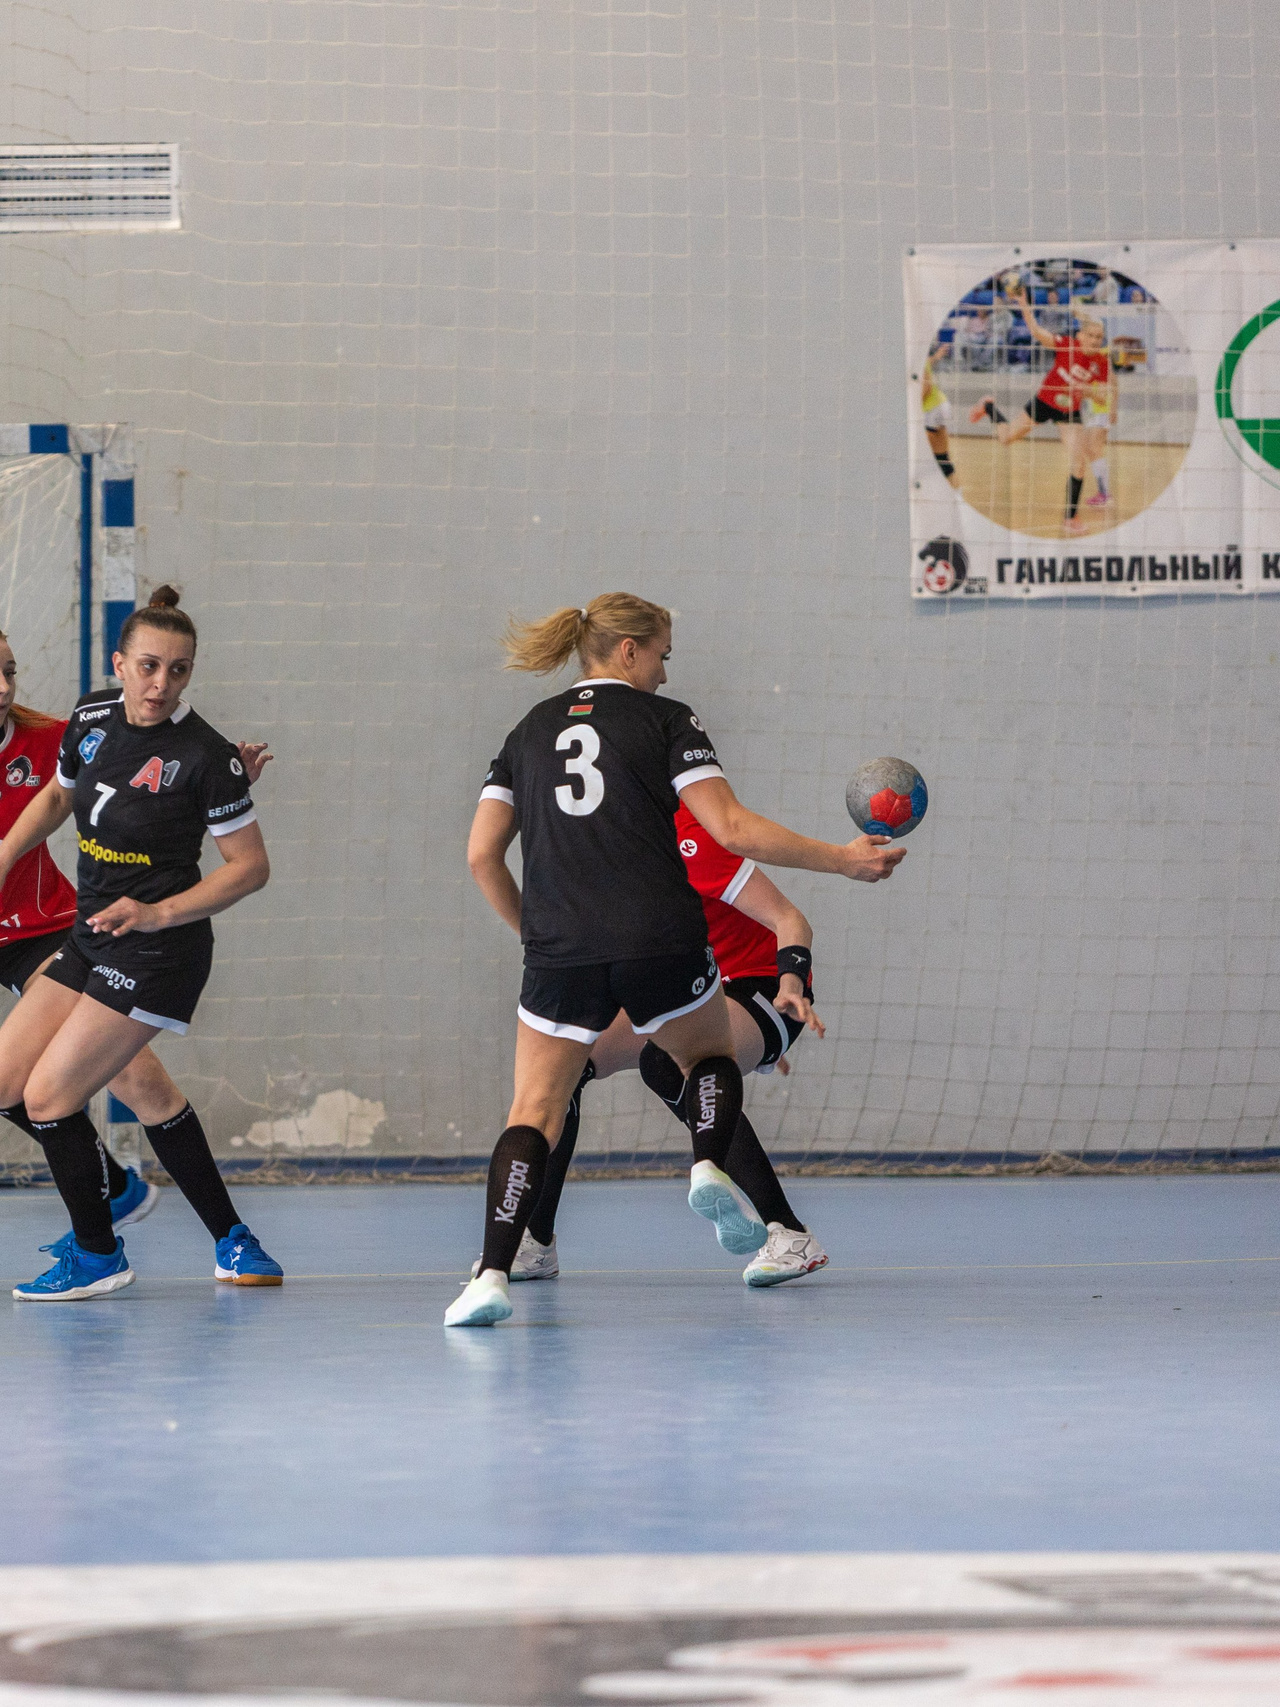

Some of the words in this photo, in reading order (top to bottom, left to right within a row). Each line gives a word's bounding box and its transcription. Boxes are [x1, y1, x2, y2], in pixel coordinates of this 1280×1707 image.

[997, 545, 1243, 583] ГАНДБОЛЬНЫЙ
[79, 708, 111, 722] Kempa
[129, 756, 181, 793] A1
[555, 723, 605, 817] 3
[89, 781, 117, 826] 7
[697, 1074, 723, 1134] Kempa
[495, 1160, 531, 1224] Kempa
